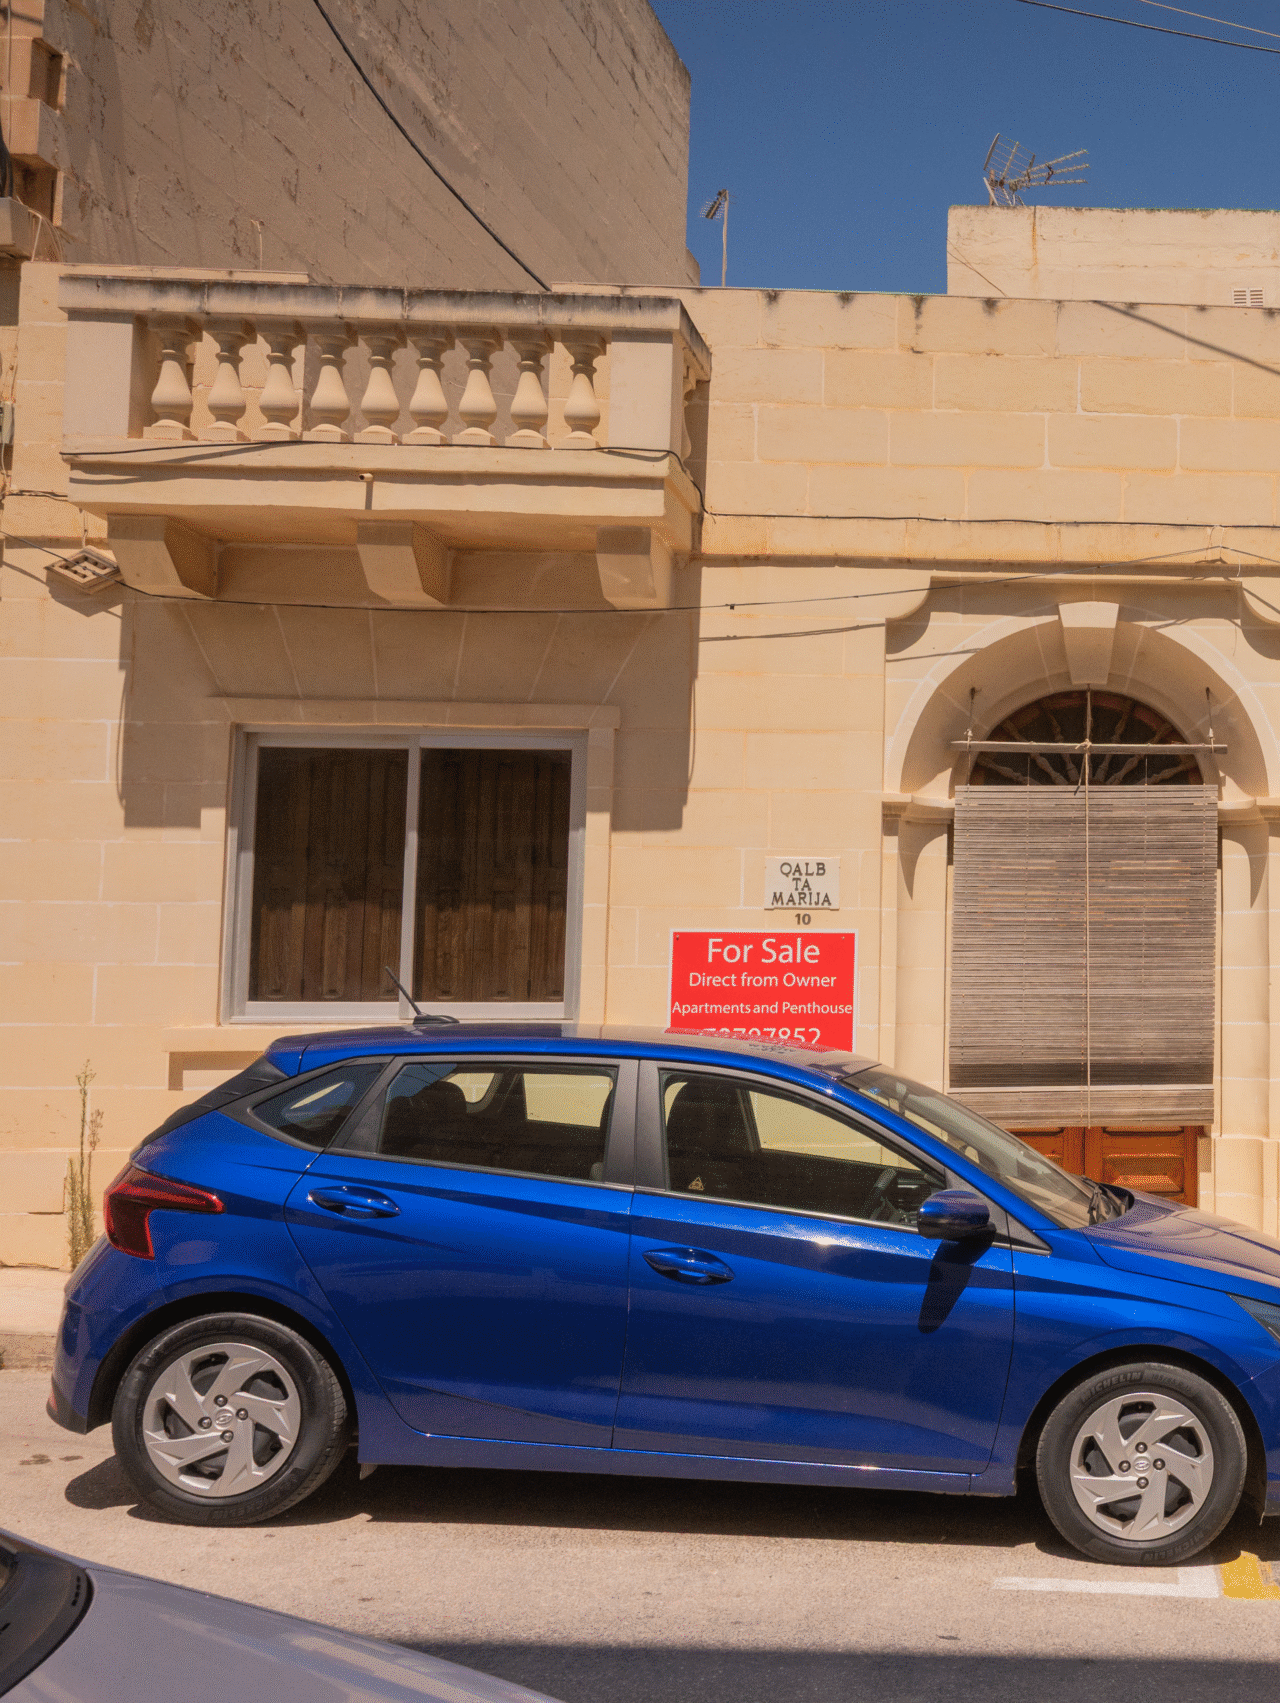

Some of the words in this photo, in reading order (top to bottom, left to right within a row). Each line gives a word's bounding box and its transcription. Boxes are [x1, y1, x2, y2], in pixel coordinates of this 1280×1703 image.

[779, 862, 827, 877] QALB
[791, 877, 812, 891] TA
[771, 891, 832, 906] MARIJA
[794, 913, 812, 925] 10
[707, 938, 753, 963] For
[761, 937, 821, 964] Sale
[689, 972, 737, 987] Direct
[740, 972, 779, 987] from
[783, 972, 837, 987] Owner
[672, 1001, 751, 1016] Apartments
[752, 1001, 778, 1014] and
[782, 1002, 853, 1014] Penthouse
